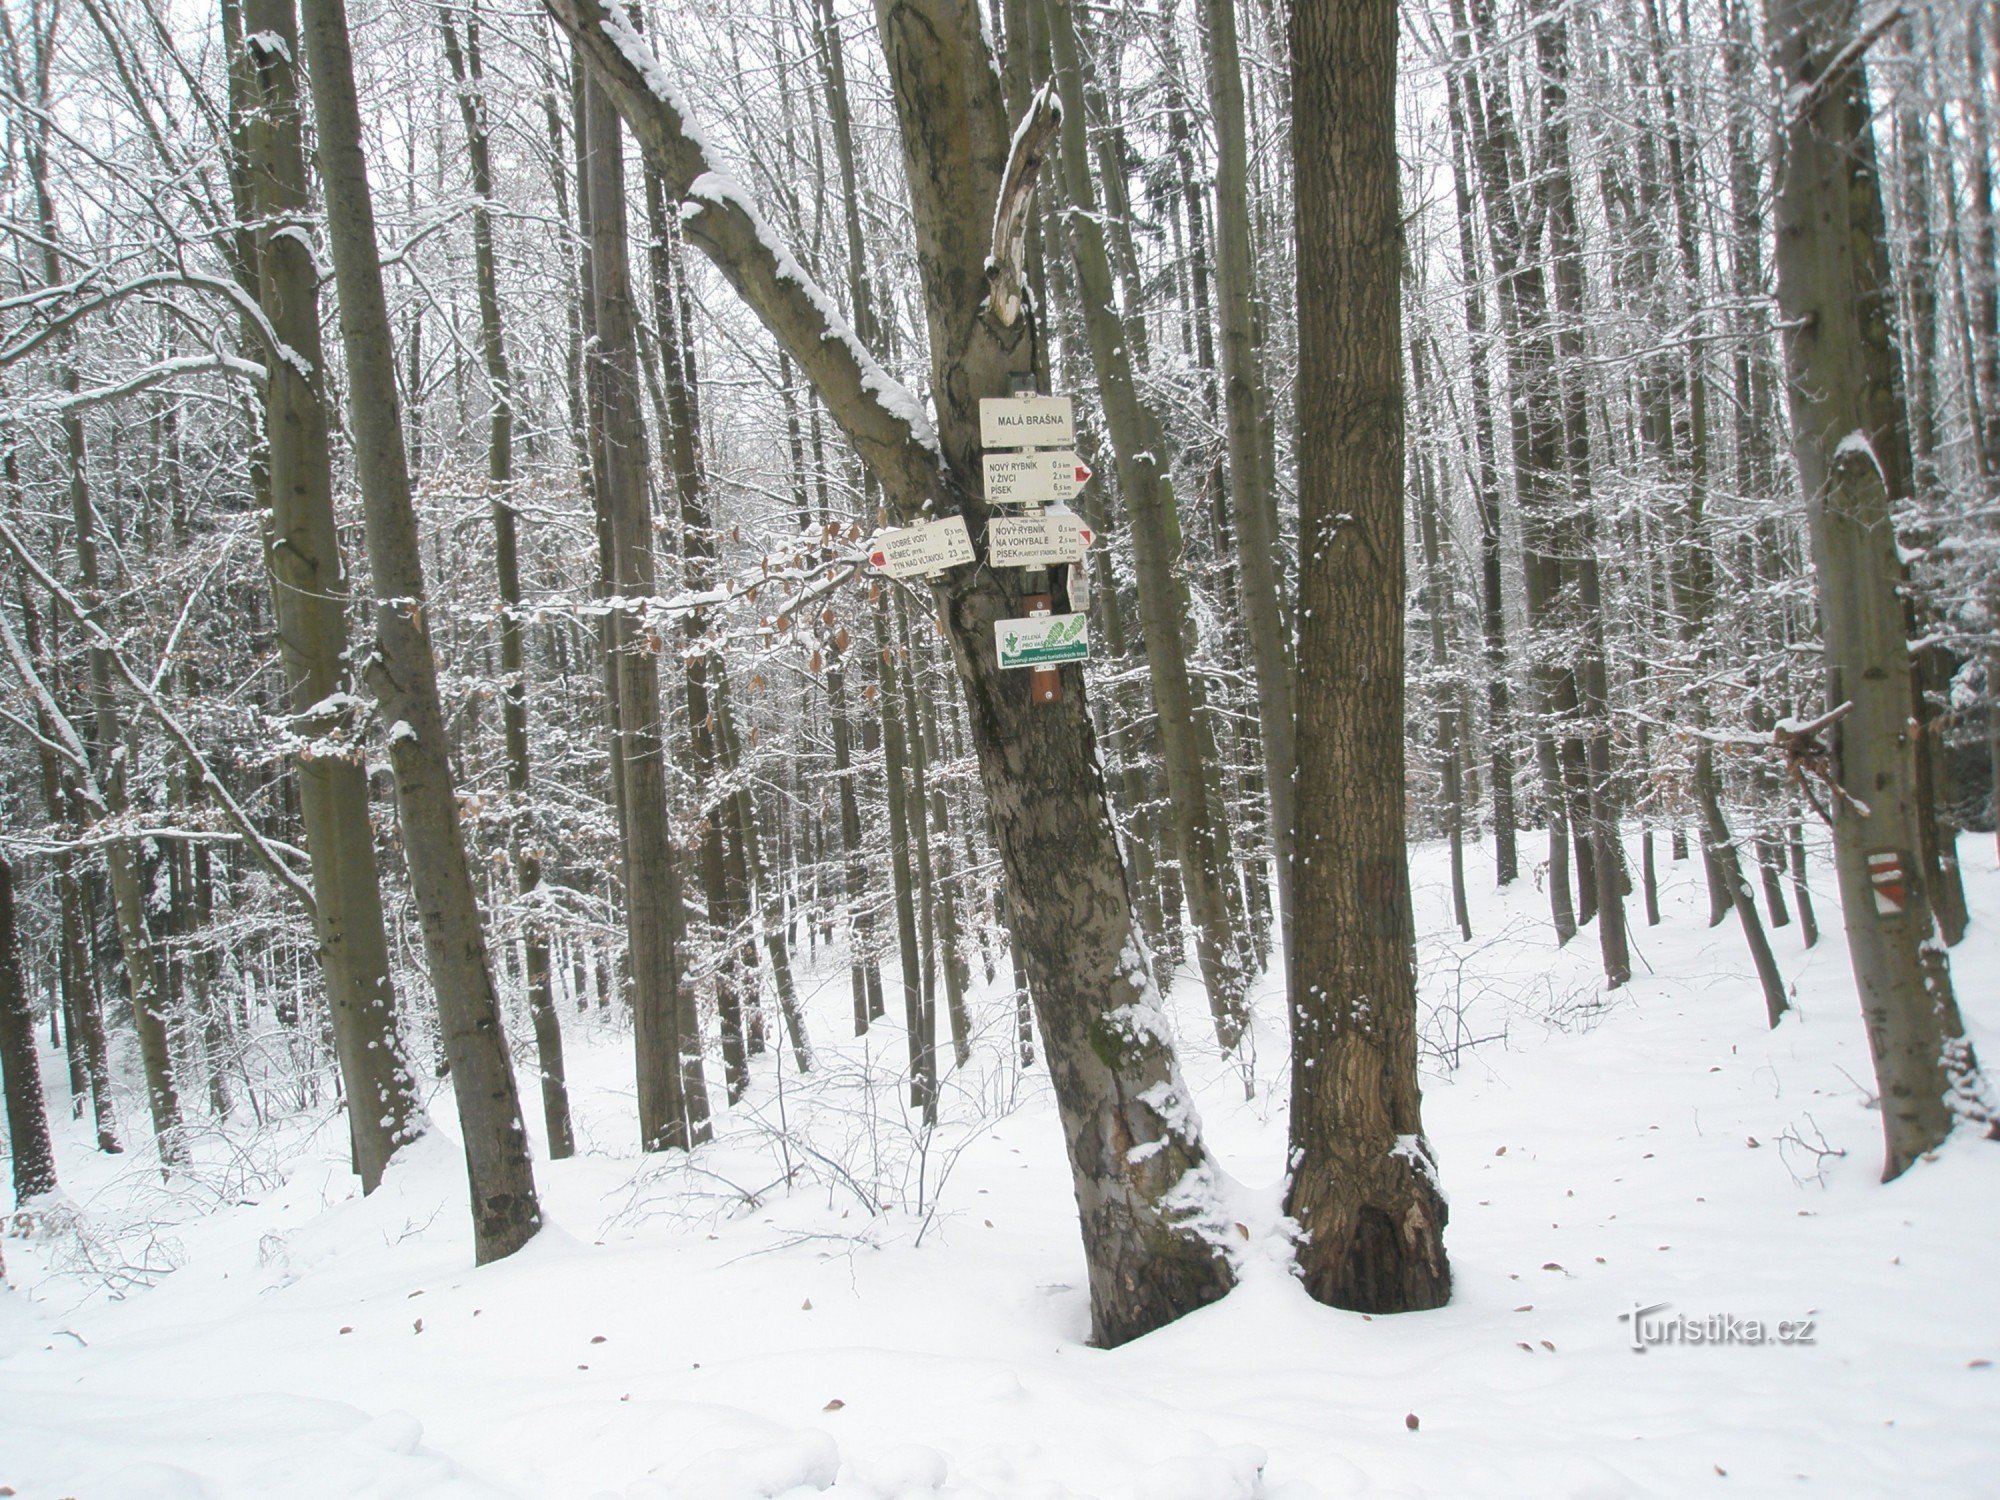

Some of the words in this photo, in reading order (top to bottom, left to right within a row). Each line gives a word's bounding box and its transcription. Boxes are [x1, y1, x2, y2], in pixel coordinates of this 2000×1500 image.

[998, 414, 1024, 426] MALÁ
[1026, 414, 1063, 425] BRAŠNA
[990, 462, 1009, 472] NOVÝ
[1011, 461, 1038, 470] RYBNÍK
[990, 475, 996, 483] V
[997, 473, 1016, 482] ŽIVCI
[991, 485, 1012, 494] PÍSEK
[1018, 524, 1045, 534] RYBNÍK
[893, 536, 911, 549] DOBRÉ
[996, 538, 1007, 546] NA
[906, 559, 918, 567] NAD
[919, 553, 943, 566] VLTAVOU
[948, 549, 958, 558] 23
[996, 548, 1018, 558] PÍSEK
[1022, 633, 1041, 641] ZELENÁ
